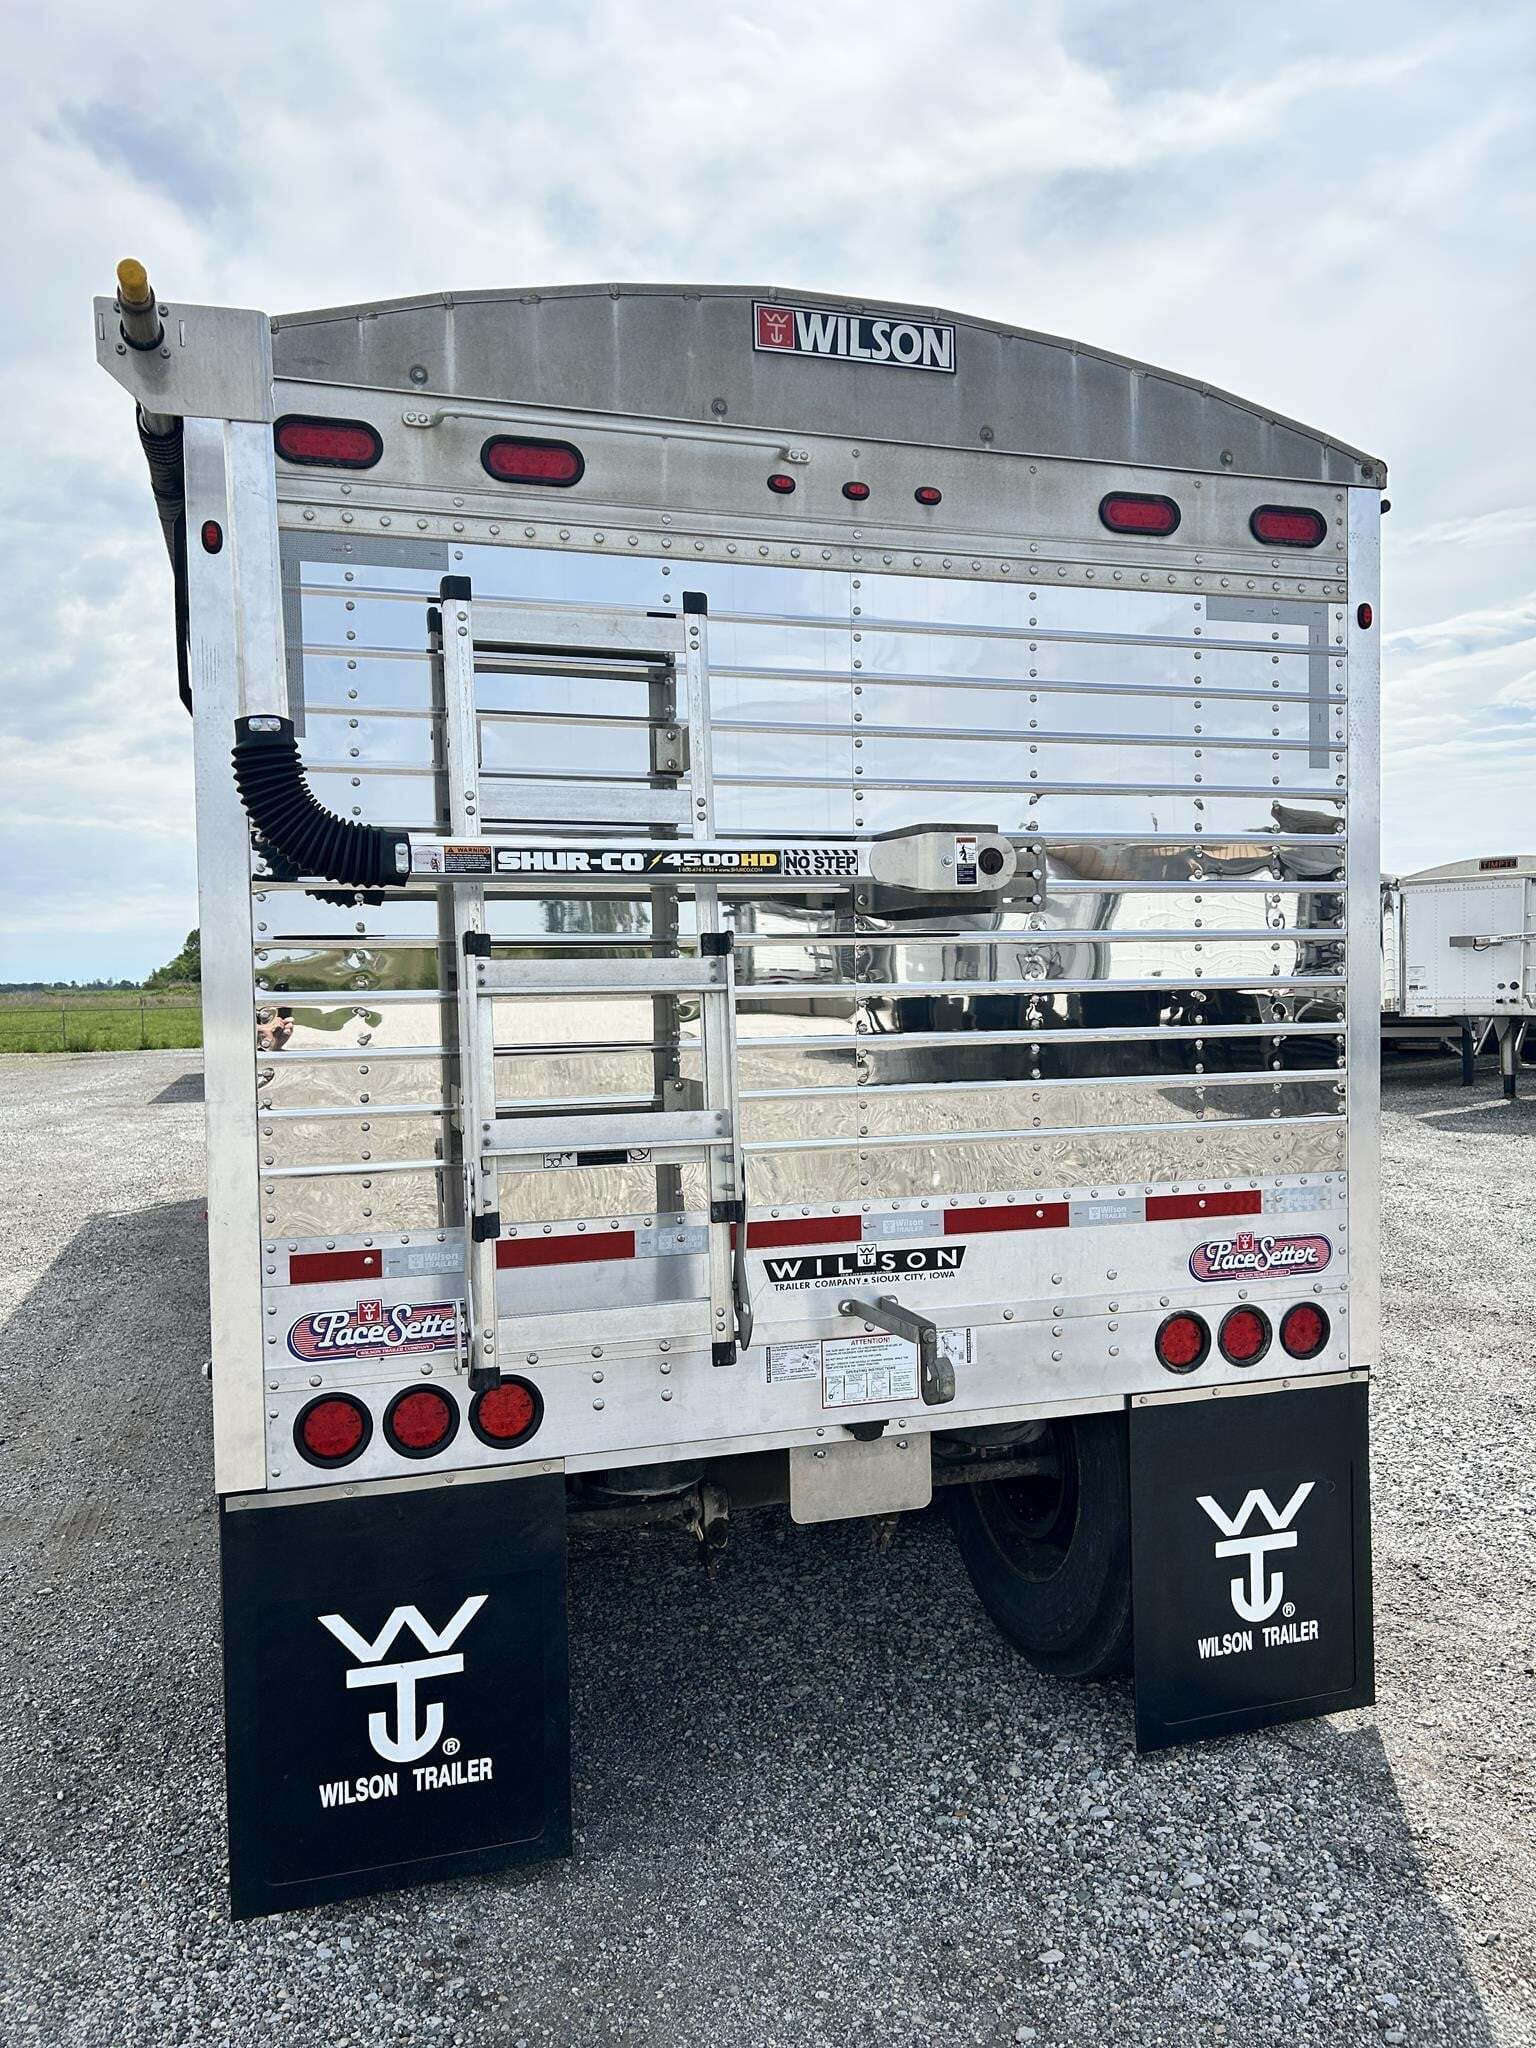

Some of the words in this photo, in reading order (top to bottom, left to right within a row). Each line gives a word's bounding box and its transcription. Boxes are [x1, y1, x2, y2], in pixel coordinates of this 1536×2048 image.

[794, 311, 951, 368] WILSON
[498, 851, 645, 871] SHUR-CO
[662, 853, 777, 866] 4500HD
[785, 856, 810, 869] NO
[814, 856, 856, 870] STEP
[770, 1249, 957, 1279] WILSON
[774, 1281, 810, 1292] TRAILER
[814, 1277, 861, 1288] COMPANY
[871, 1274, 900, 1284] SIOUX
[904, 1273, 926, 1281] CITY,
[929, 1271, 955, 1279] IOWA
[850, 1337, 890, 1346] ATTENTION!
[1198, 1630, 1253, 1659] WILSON
[1262, 1620, 1319, 1648] TRAILER
[319, 1772, 399, 1808] WILSON
[412, 1757, 493, 1792] TRAILER
